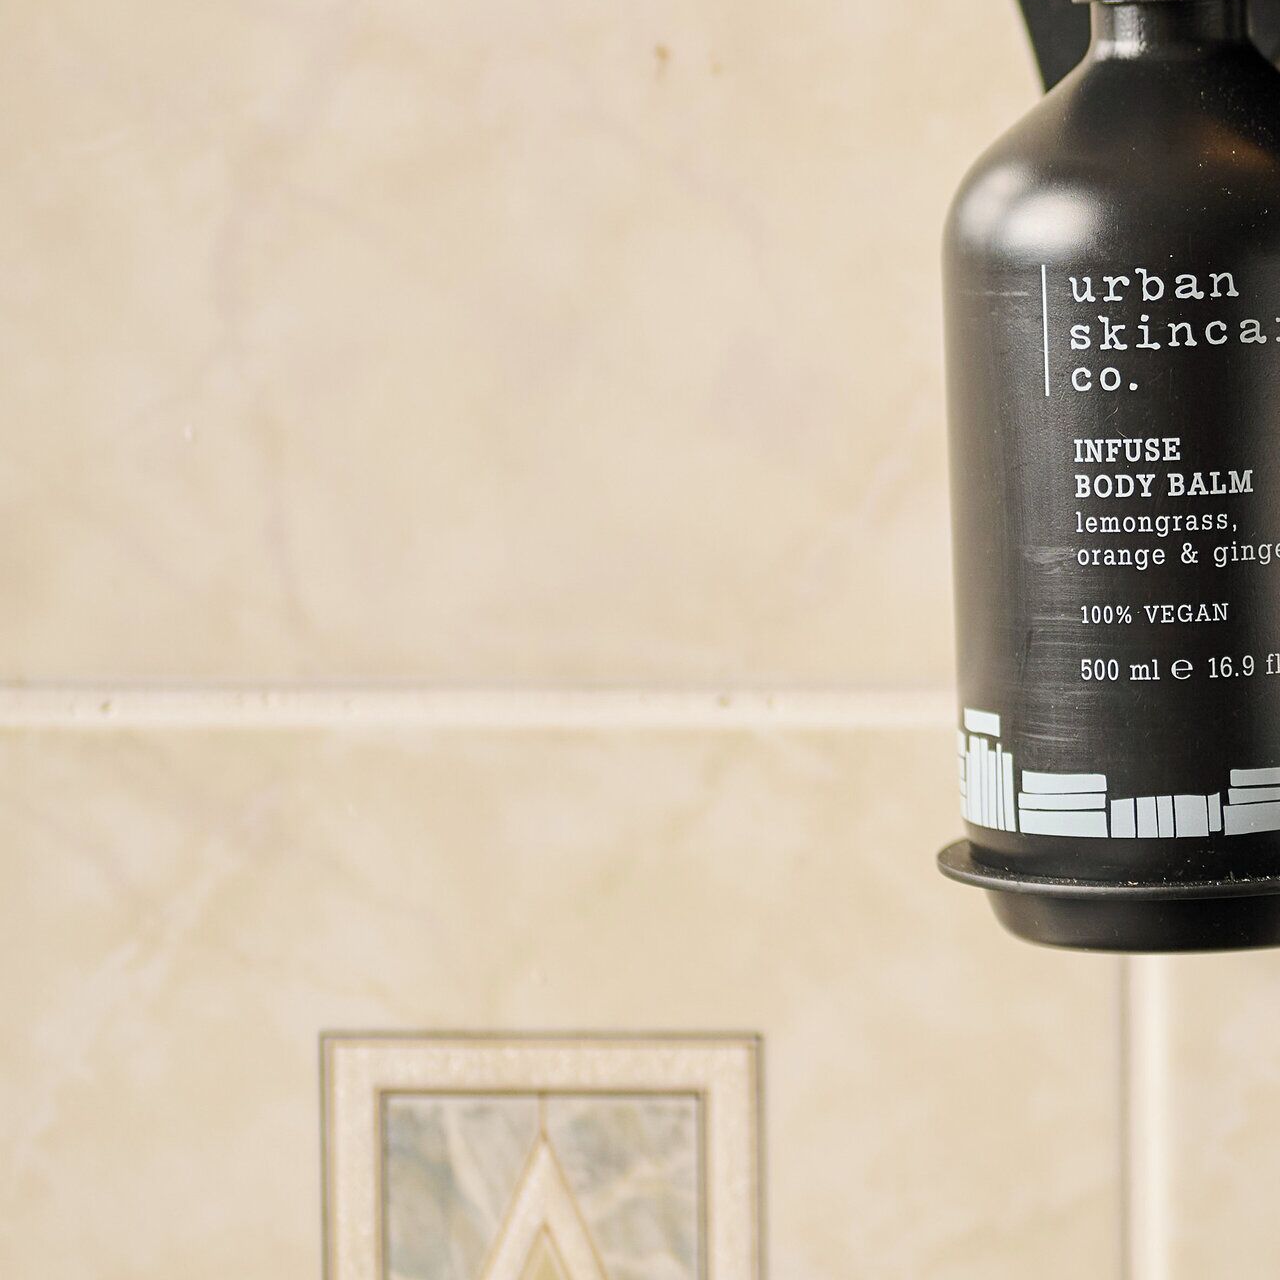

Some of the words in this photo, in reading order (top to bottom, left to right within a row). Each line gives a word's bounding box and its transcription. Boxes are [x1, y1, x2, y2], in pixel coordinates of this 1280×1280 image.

[1067, 267, 1240, 303] urban
[1071, 366, 1138, 392] co.
[1073, 437, 1181, 463] INFUSE
[1074, 473, 1156, 498] BODY
[1166, 469, 1254, 497] BALM
[1075, 510, 1237, 538] lemongrass,
[1077, 548, 1166, 571] orange
[1180, 542, 1199, 564] &
[1080, 605, 1132, 624] 100%
[1143, 602, 1229, 624] VEGAN
[1081, 658, 1119, 681] 500
[1129, 659, 1161, 681] ml
[1208, 655, 1255, 678] 16.9
